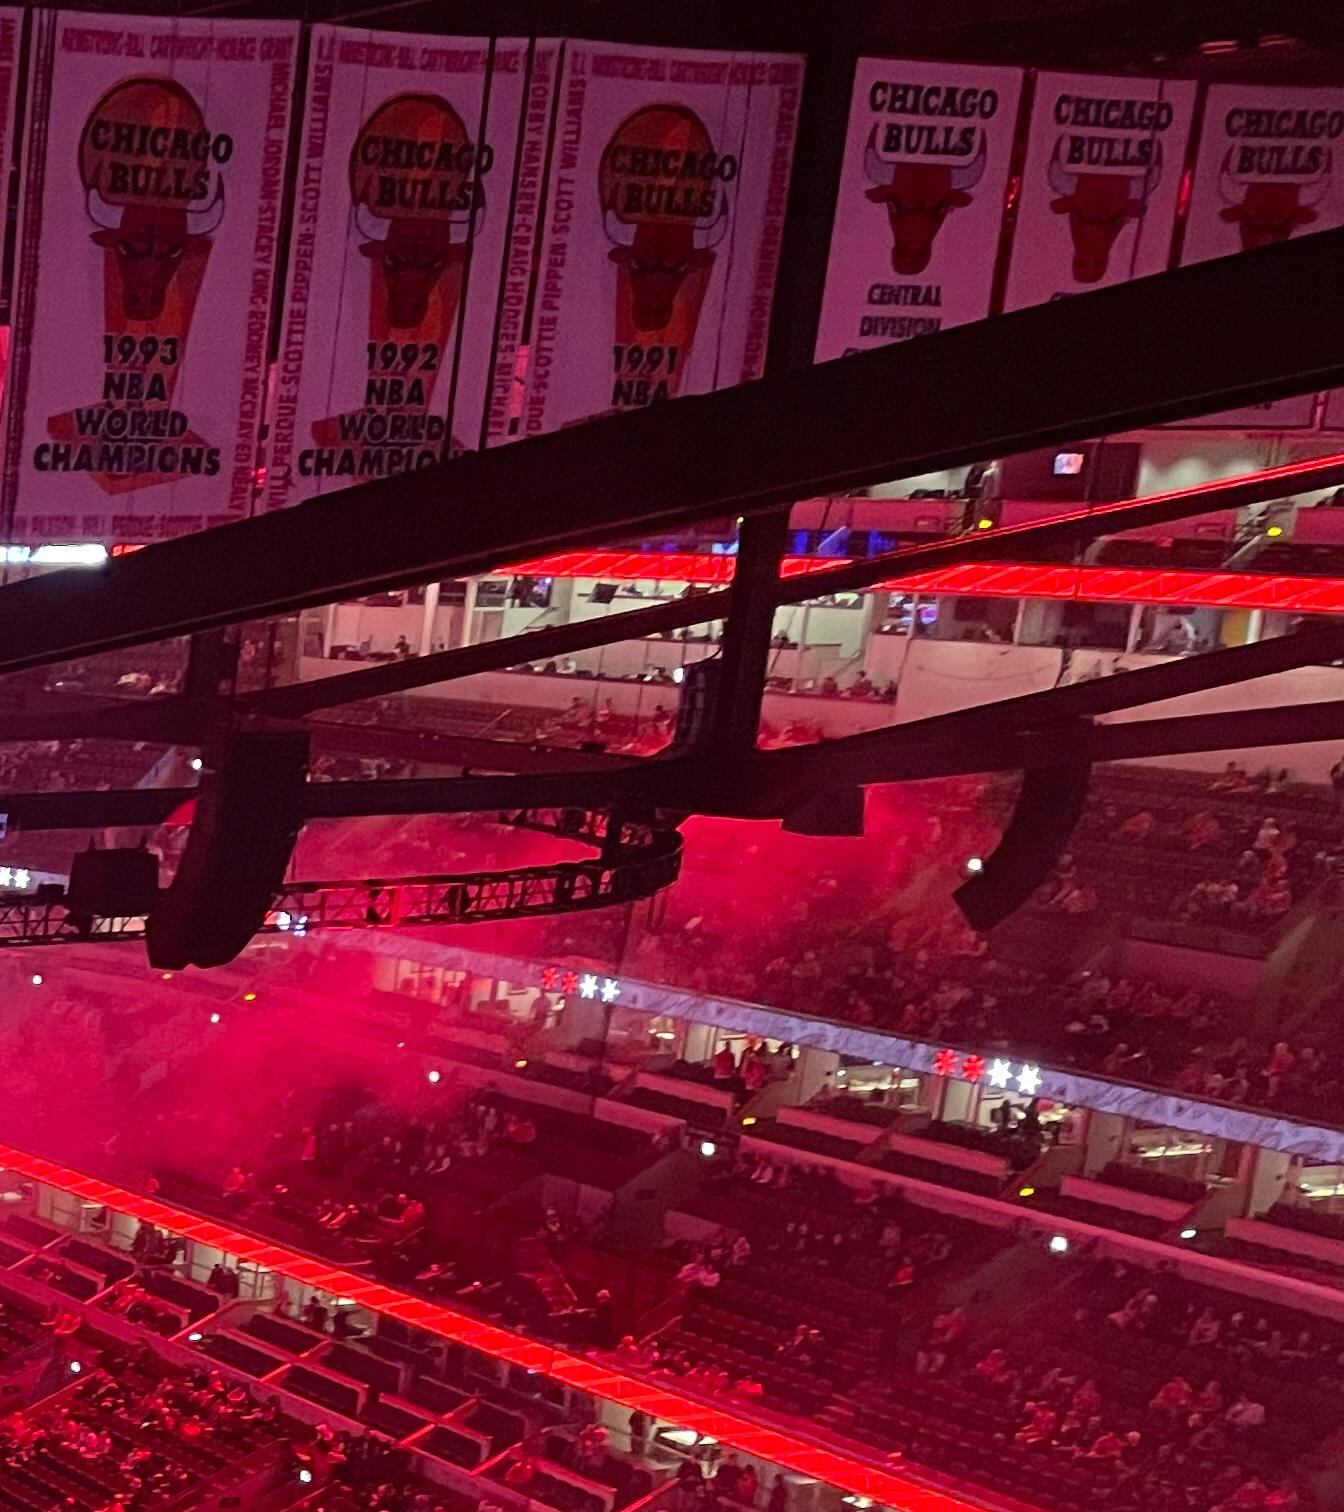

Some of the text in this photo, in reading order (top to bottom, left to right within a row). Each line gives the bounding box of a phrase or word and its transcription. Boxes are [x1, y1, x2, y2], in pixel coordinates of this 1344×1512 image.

[268, 62, 291, 130] MICHAEL
[869, 81, 998, 120] CHICAGO
[1055, 94, 1173, 132] CHICAGO
[1226, 107, 1344, 139] CHICAGO
[90, 119, 233, 164] CHICAGO
[361, 136, 494, 175] CHICAGO
[884, 123, 976, 157] BULLS
[1068, 135, 1155, 168] BULLS
[611, 145, 737, 182] CHICAGO
[1237, 145, 1323, 175] BULLS
[109, 160, 210, 200] BULLS
[378, 175, 474, 211] BULLS
[623, 183, 714, 218] BULLS
[541, 243, 566, 311] PIPPEN
[867, 283, 942, 308] CENTRAL
[103, 336, 178, 366] 1993
[366, 342, 439, 371] 1992
[613, 345, 679, 373] 1991
[102, 372, 167, 401] NBA
[365, 378, 425, 407] NBA
[613, 380, 672, 407] NBA
[75, 408, 188, 439] WORLD
[338, 413, 446, 442] WORLD
[33, 441, 221, 477] CHAMPIONS
